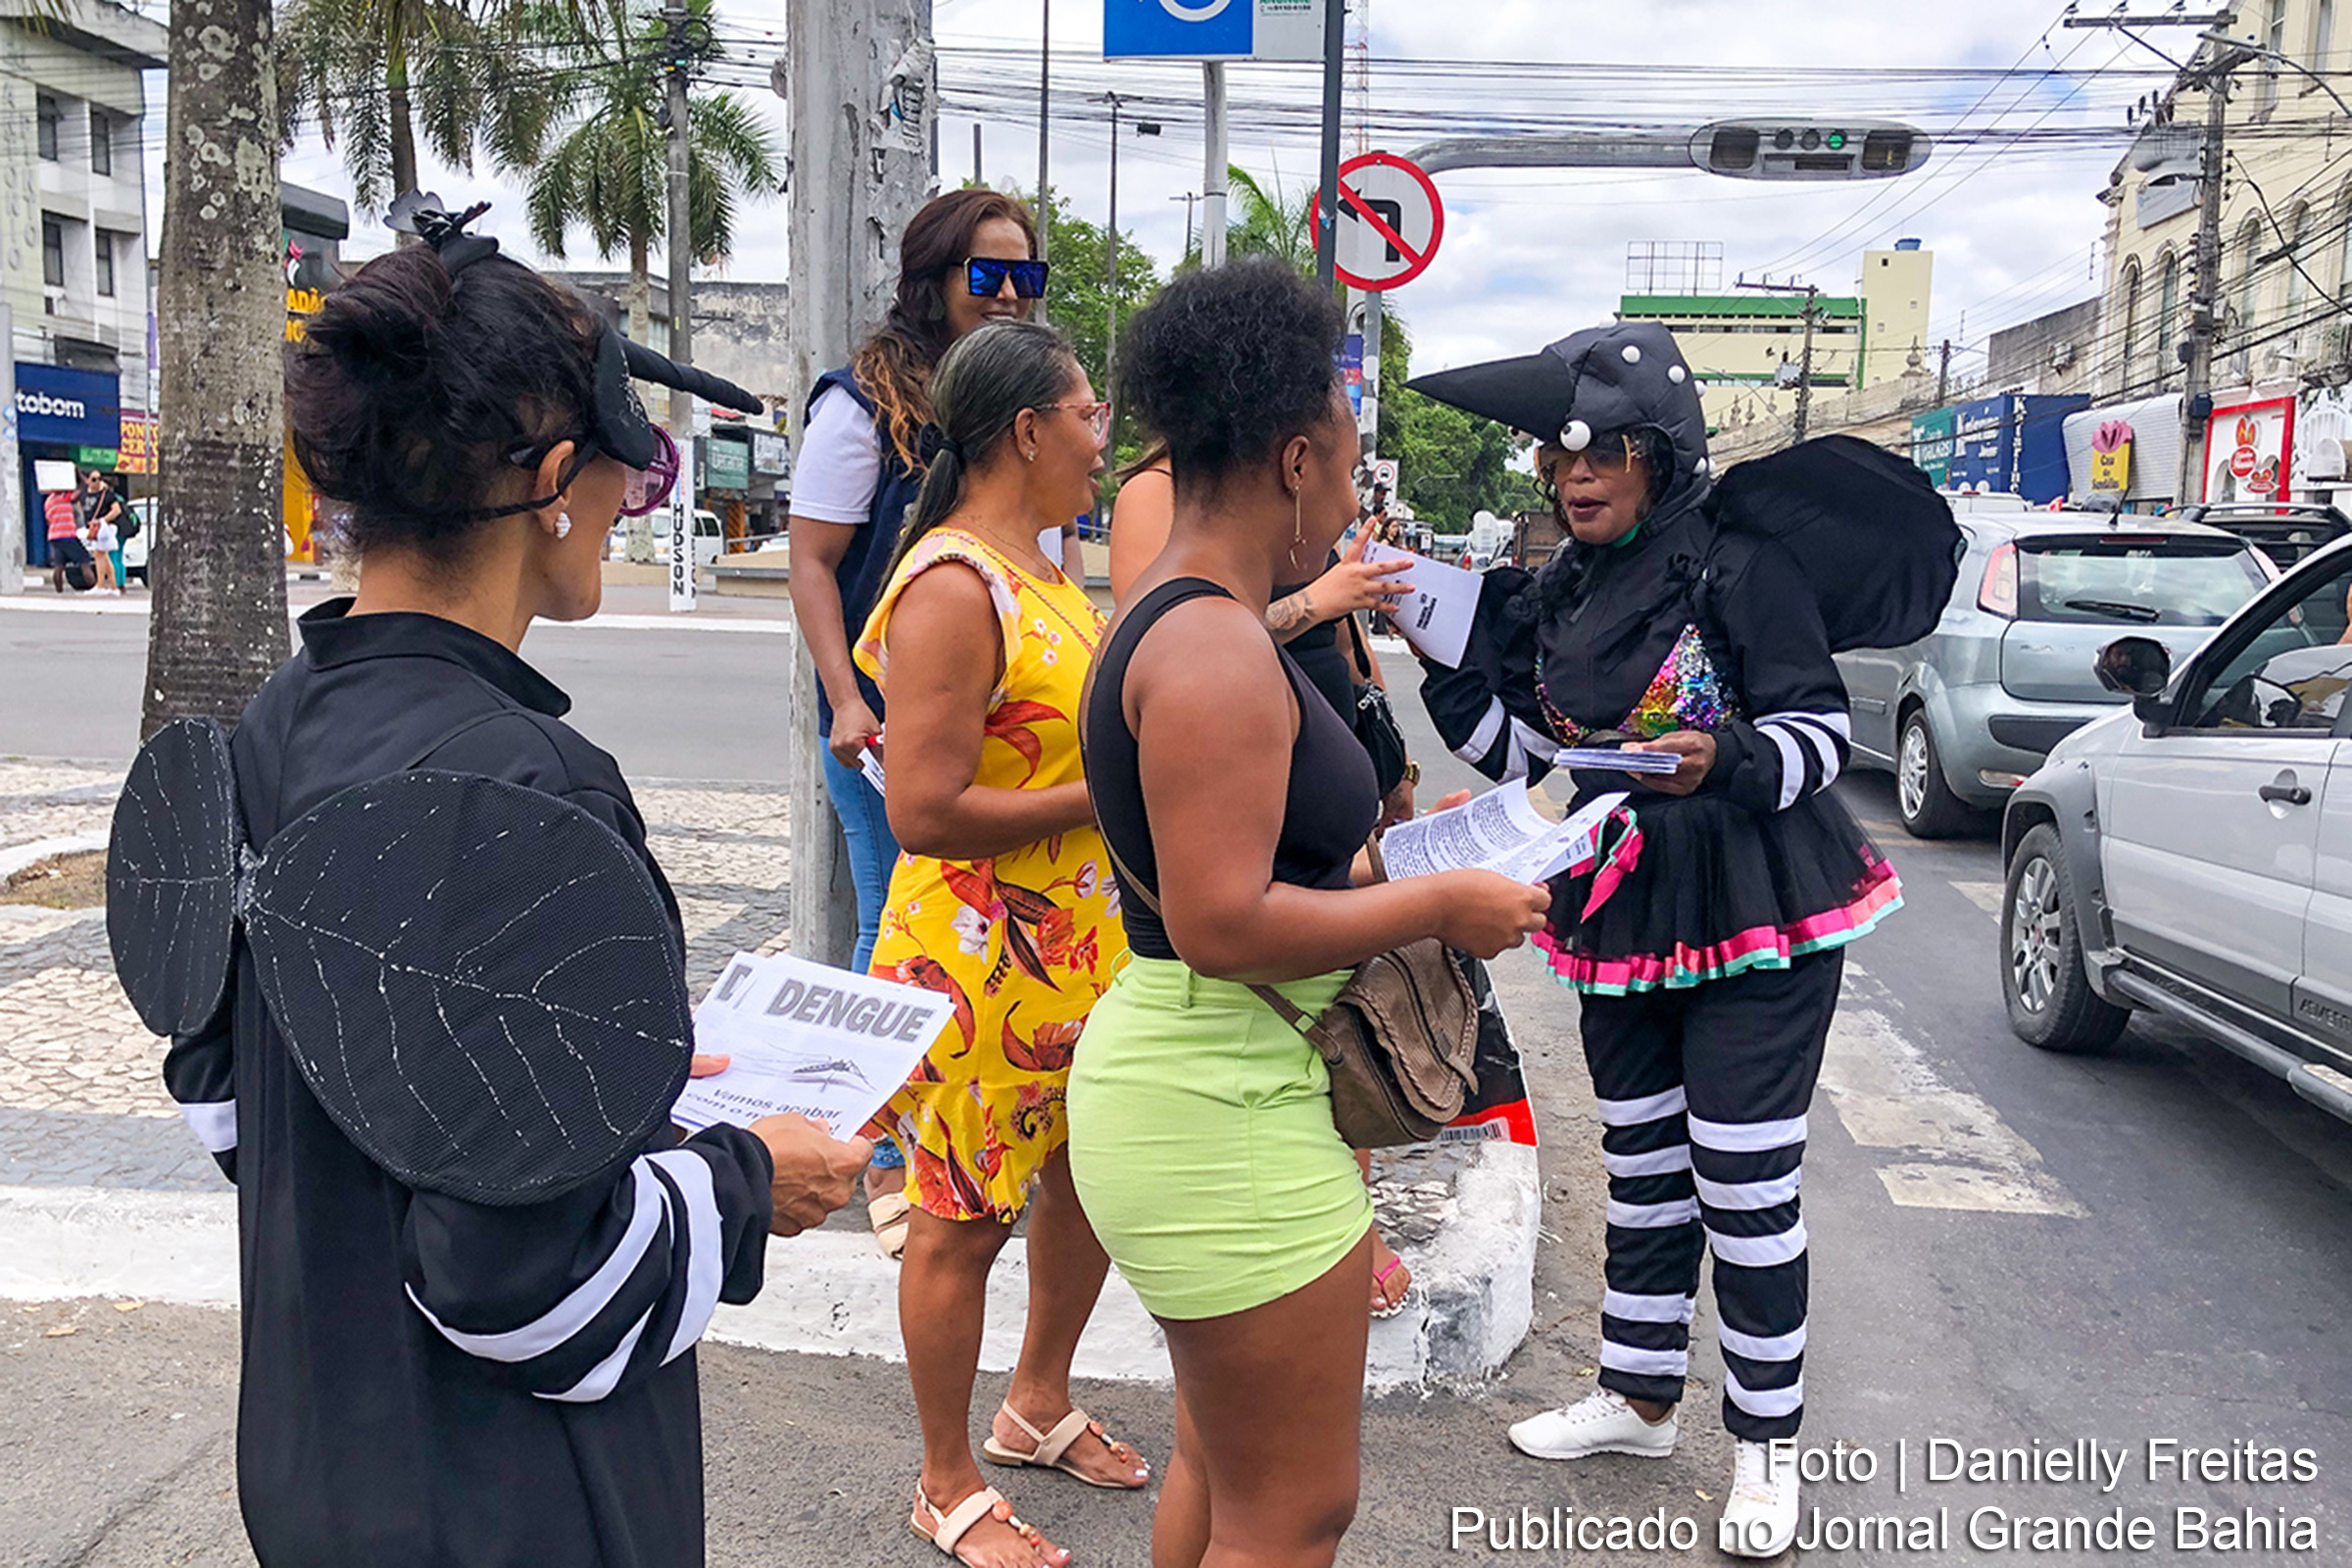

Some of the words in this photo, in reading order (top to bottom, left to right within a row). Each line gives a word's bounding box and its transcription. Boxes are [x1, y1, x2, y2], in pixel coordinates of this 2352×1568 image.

[673, 503, 684, 596] HUDSON
[765, 979, 933, 1043] DENGUE
[687, 1092, 726, 1109] com
[713, 1089, 773, 1109] Vamos
